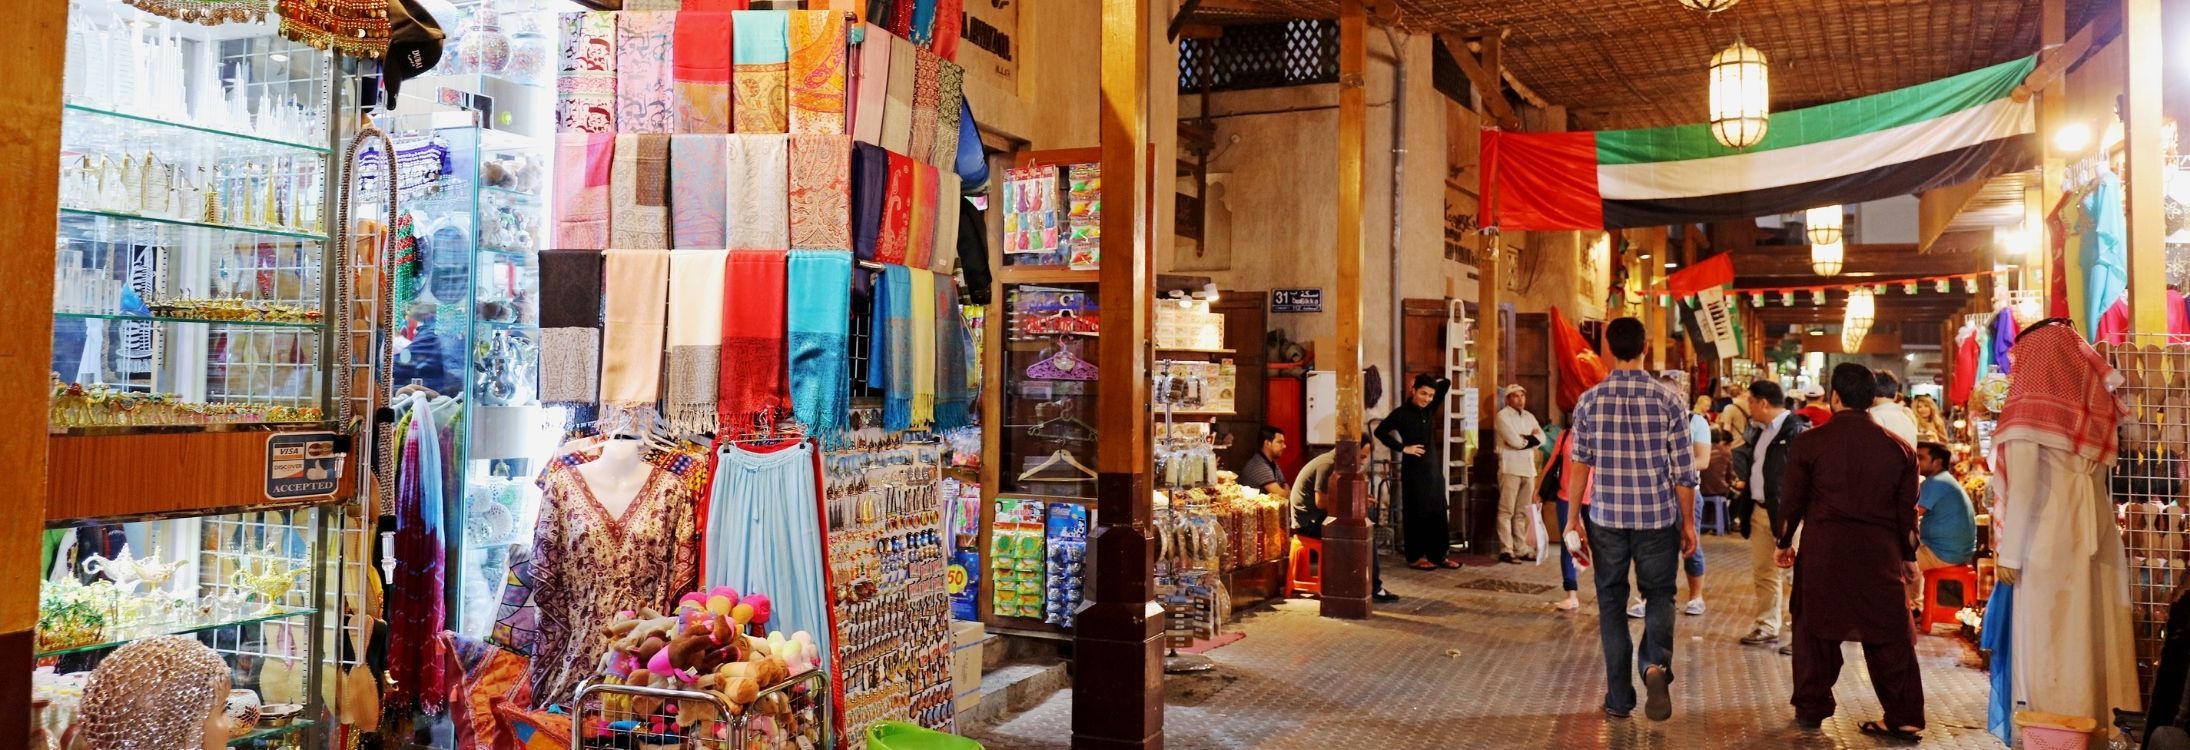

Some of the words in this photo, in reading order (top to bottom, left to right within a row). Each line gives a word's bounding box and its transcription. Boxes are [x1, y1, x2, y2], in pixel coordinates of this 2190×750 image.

[1275, 291, 1289, 304] 31
[280, 447, 299, 455] VISA
[272, 481, 334, 494] ACCEPTED
